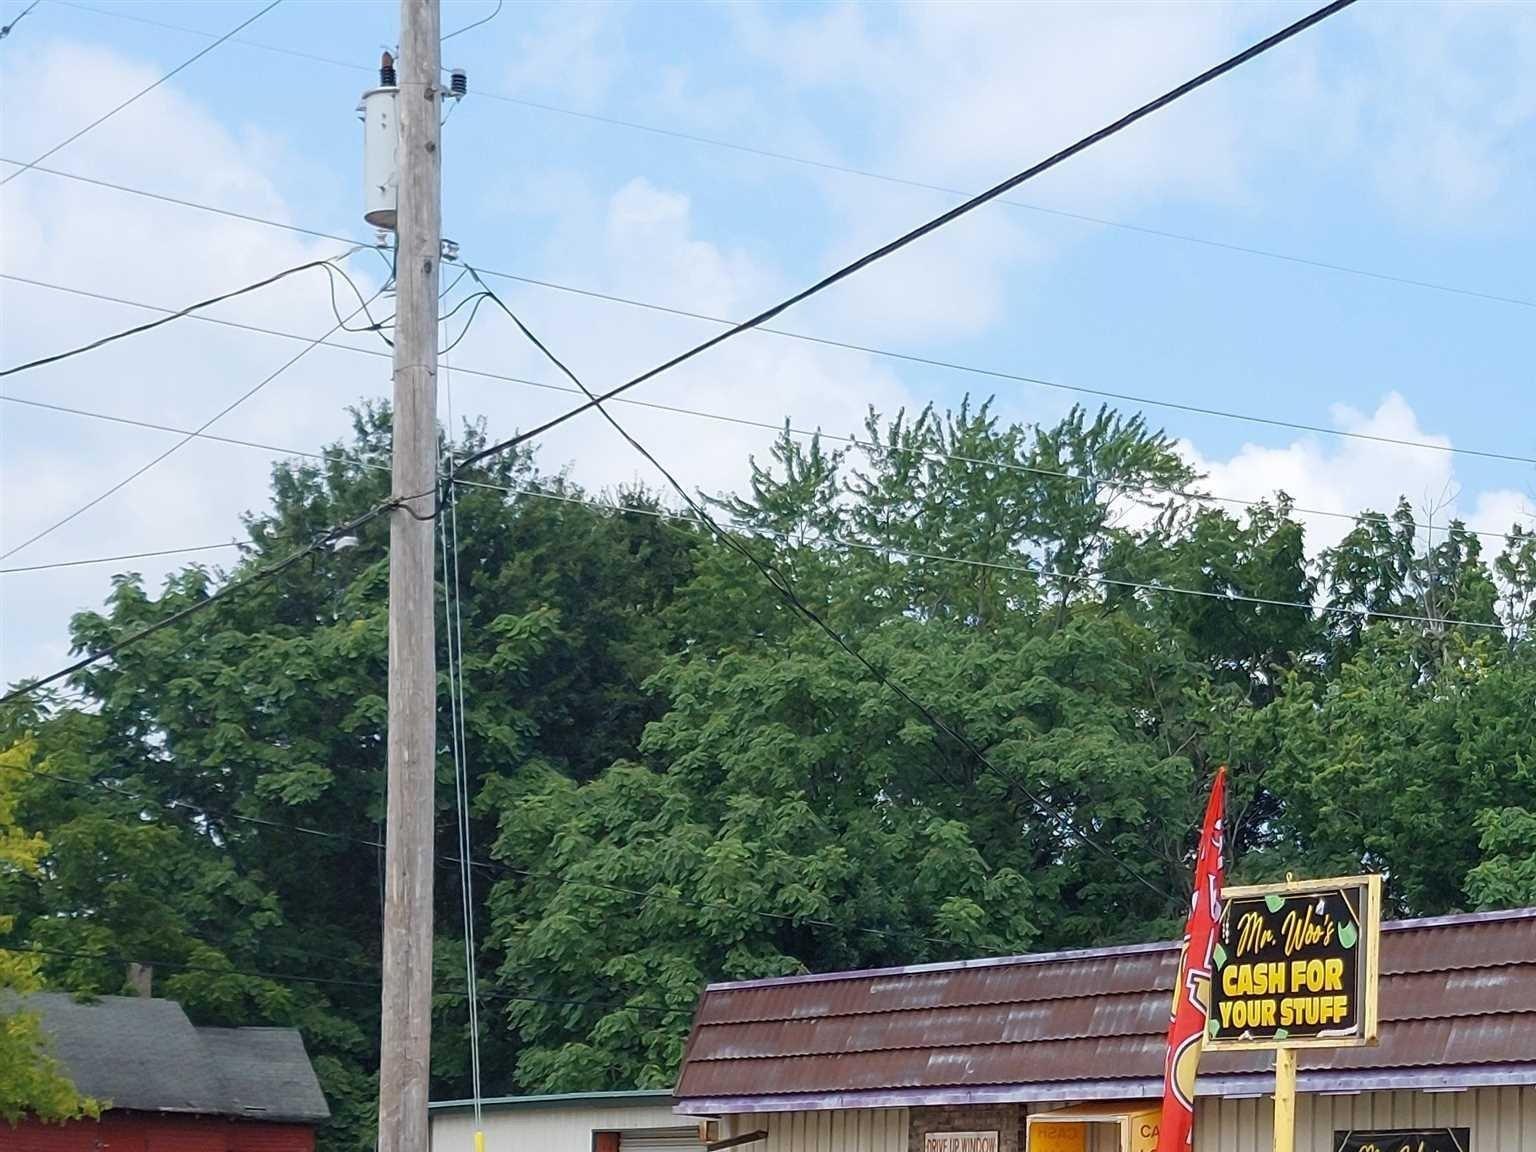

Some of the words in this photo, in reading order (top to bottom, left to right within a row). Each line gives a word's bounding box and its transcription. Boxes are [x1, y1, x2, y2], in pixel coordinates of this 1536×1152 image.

[1236, 911, 1276, 957] Mr.
[1281, 904, 1335, 957] Woo's
[1222, 961, 1285, 997] CASH
[1291, 958, 1344, 993] FOR
[1219, 999, 1276, 1029] YOUR
[1280, 996, 1348, 1026] STUFF
[1140, 1124, 1160, 1138] CA
